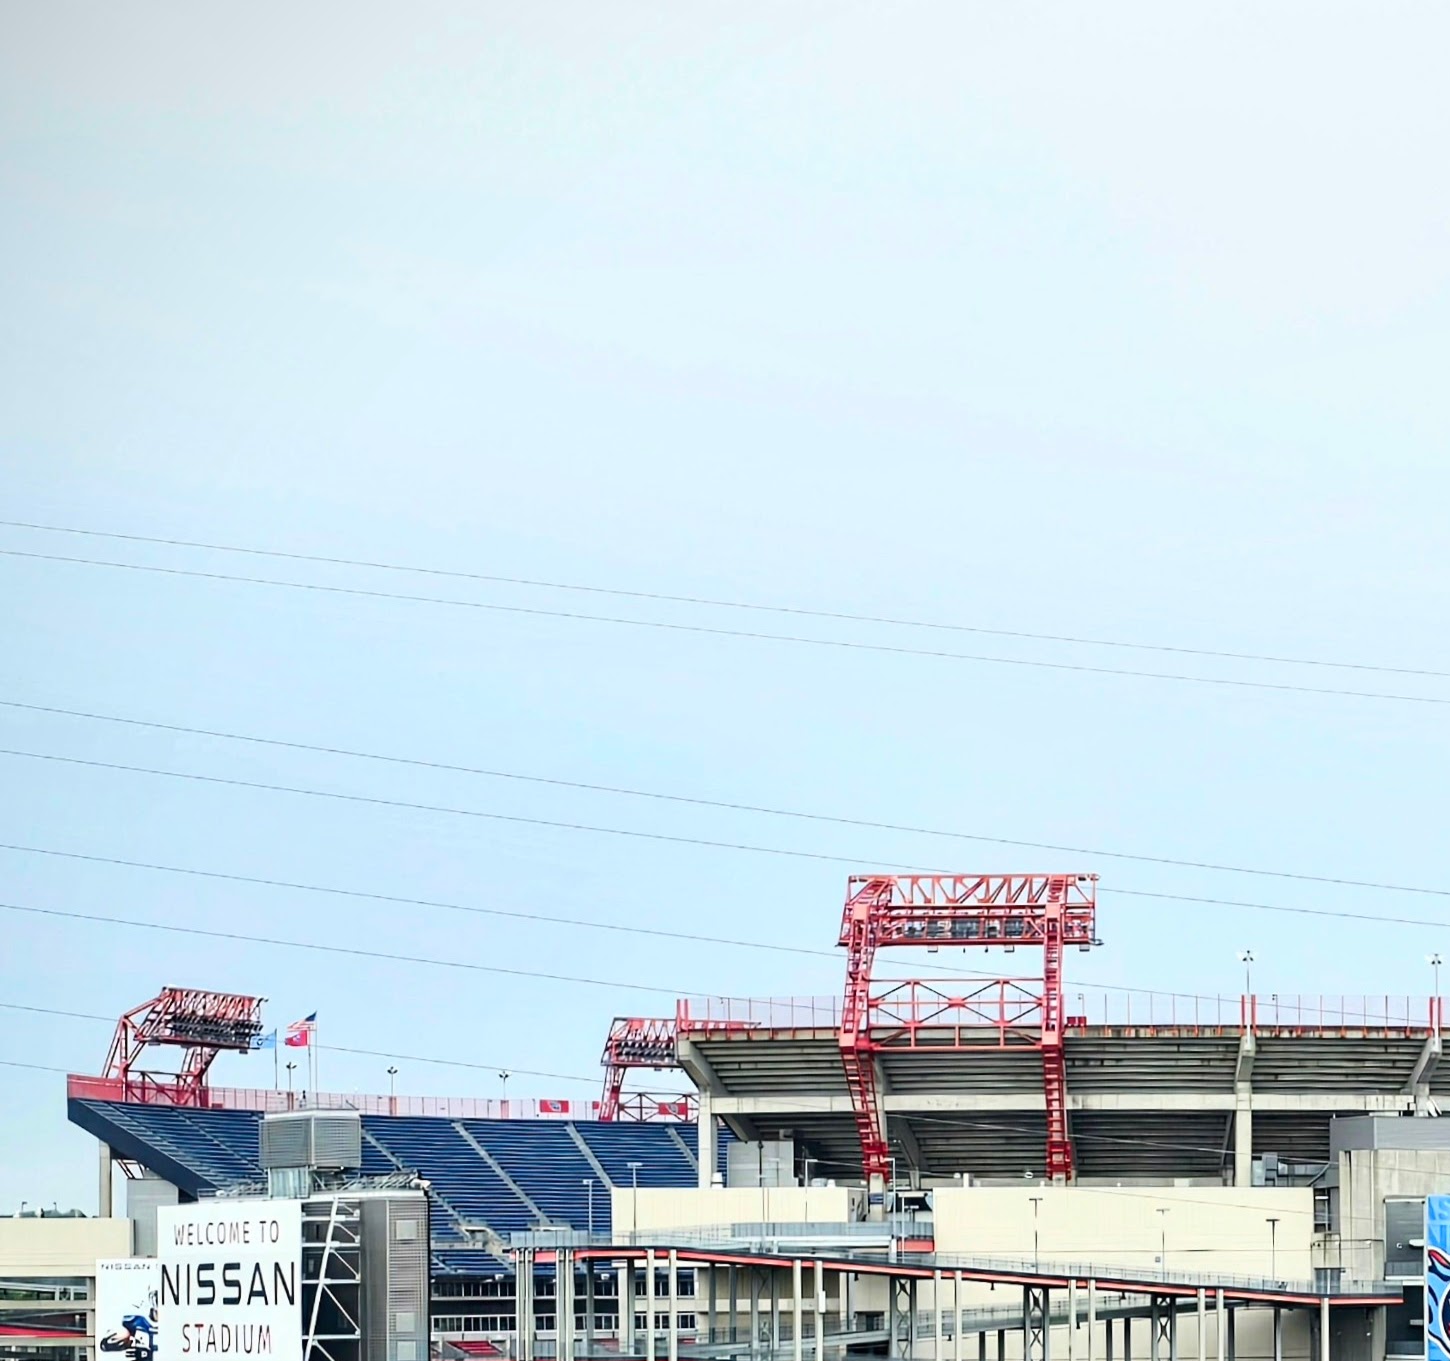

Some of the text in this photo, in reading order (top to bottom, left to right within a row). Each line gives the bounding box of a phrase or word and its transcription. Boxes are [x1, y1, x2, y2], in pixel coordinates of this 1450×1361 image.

[174, 1220, 279, 1246] WELCOME TO
[161, 1262, 295, 1306] NISSAN
[182, 1323, 272, 1354] STADIUM
